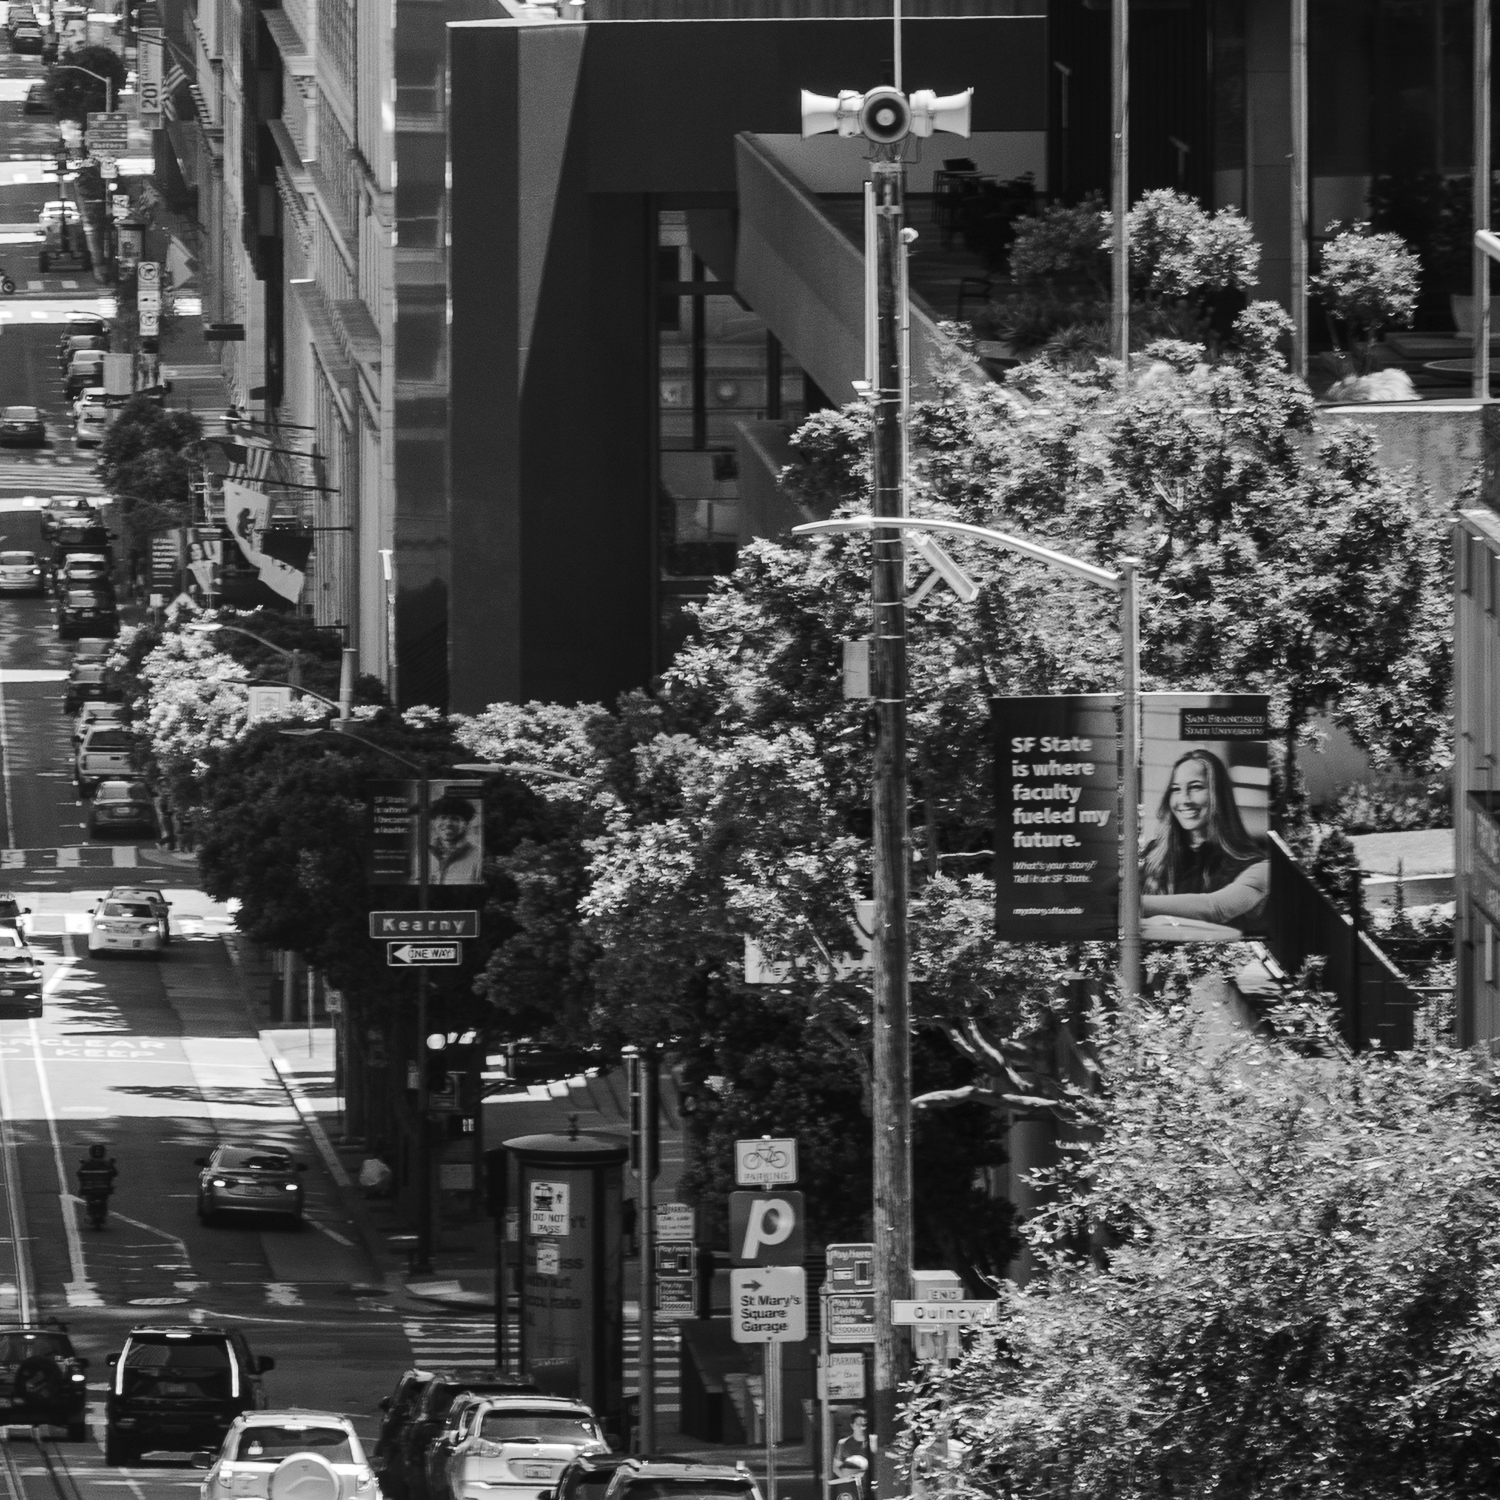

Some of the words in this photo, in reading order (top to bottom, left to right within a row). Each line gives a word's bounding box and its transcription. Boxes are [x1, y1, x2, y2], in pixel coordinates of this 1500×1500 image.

[141, 82, 158, 109] 201
[1011, 736, 1036, 753] SF
[1040, 735, 1093, 752] State
[1011, 760, 1030, 777] is
[1032, 760, 1096, 776] where
[1012, 783, 1082, 804] faculty
[1012, 807, 1075, 825] fueled
[1079, 809, 1112, 827] my
[1012, 831, 1082, 849] future.
[382, 917, 466, 934] Kearny
[408, 949, 429, 959] ONE
[431, 948, 453, 958] WAY
[40, 1038, 167, 1049] CLEAR
[55, 1048, 155, 1058] KEEP
[743, 1171, 789, 1181] PARKING
[532, 1213, 546, 1223] DO
[549, 1214, 565, 1223] NOT
[537, 1225, 562, 1234] PASS
[931, 1290, 958, 1299] END
[740, 1295, 756, 1306] St
[757, 1295, 802, 1308] Mary's
[740, 1308, 787, 1321] Square
[913, 1306, 982, 1323] Quincy
[740, 1321, 788, 1333] Garage
